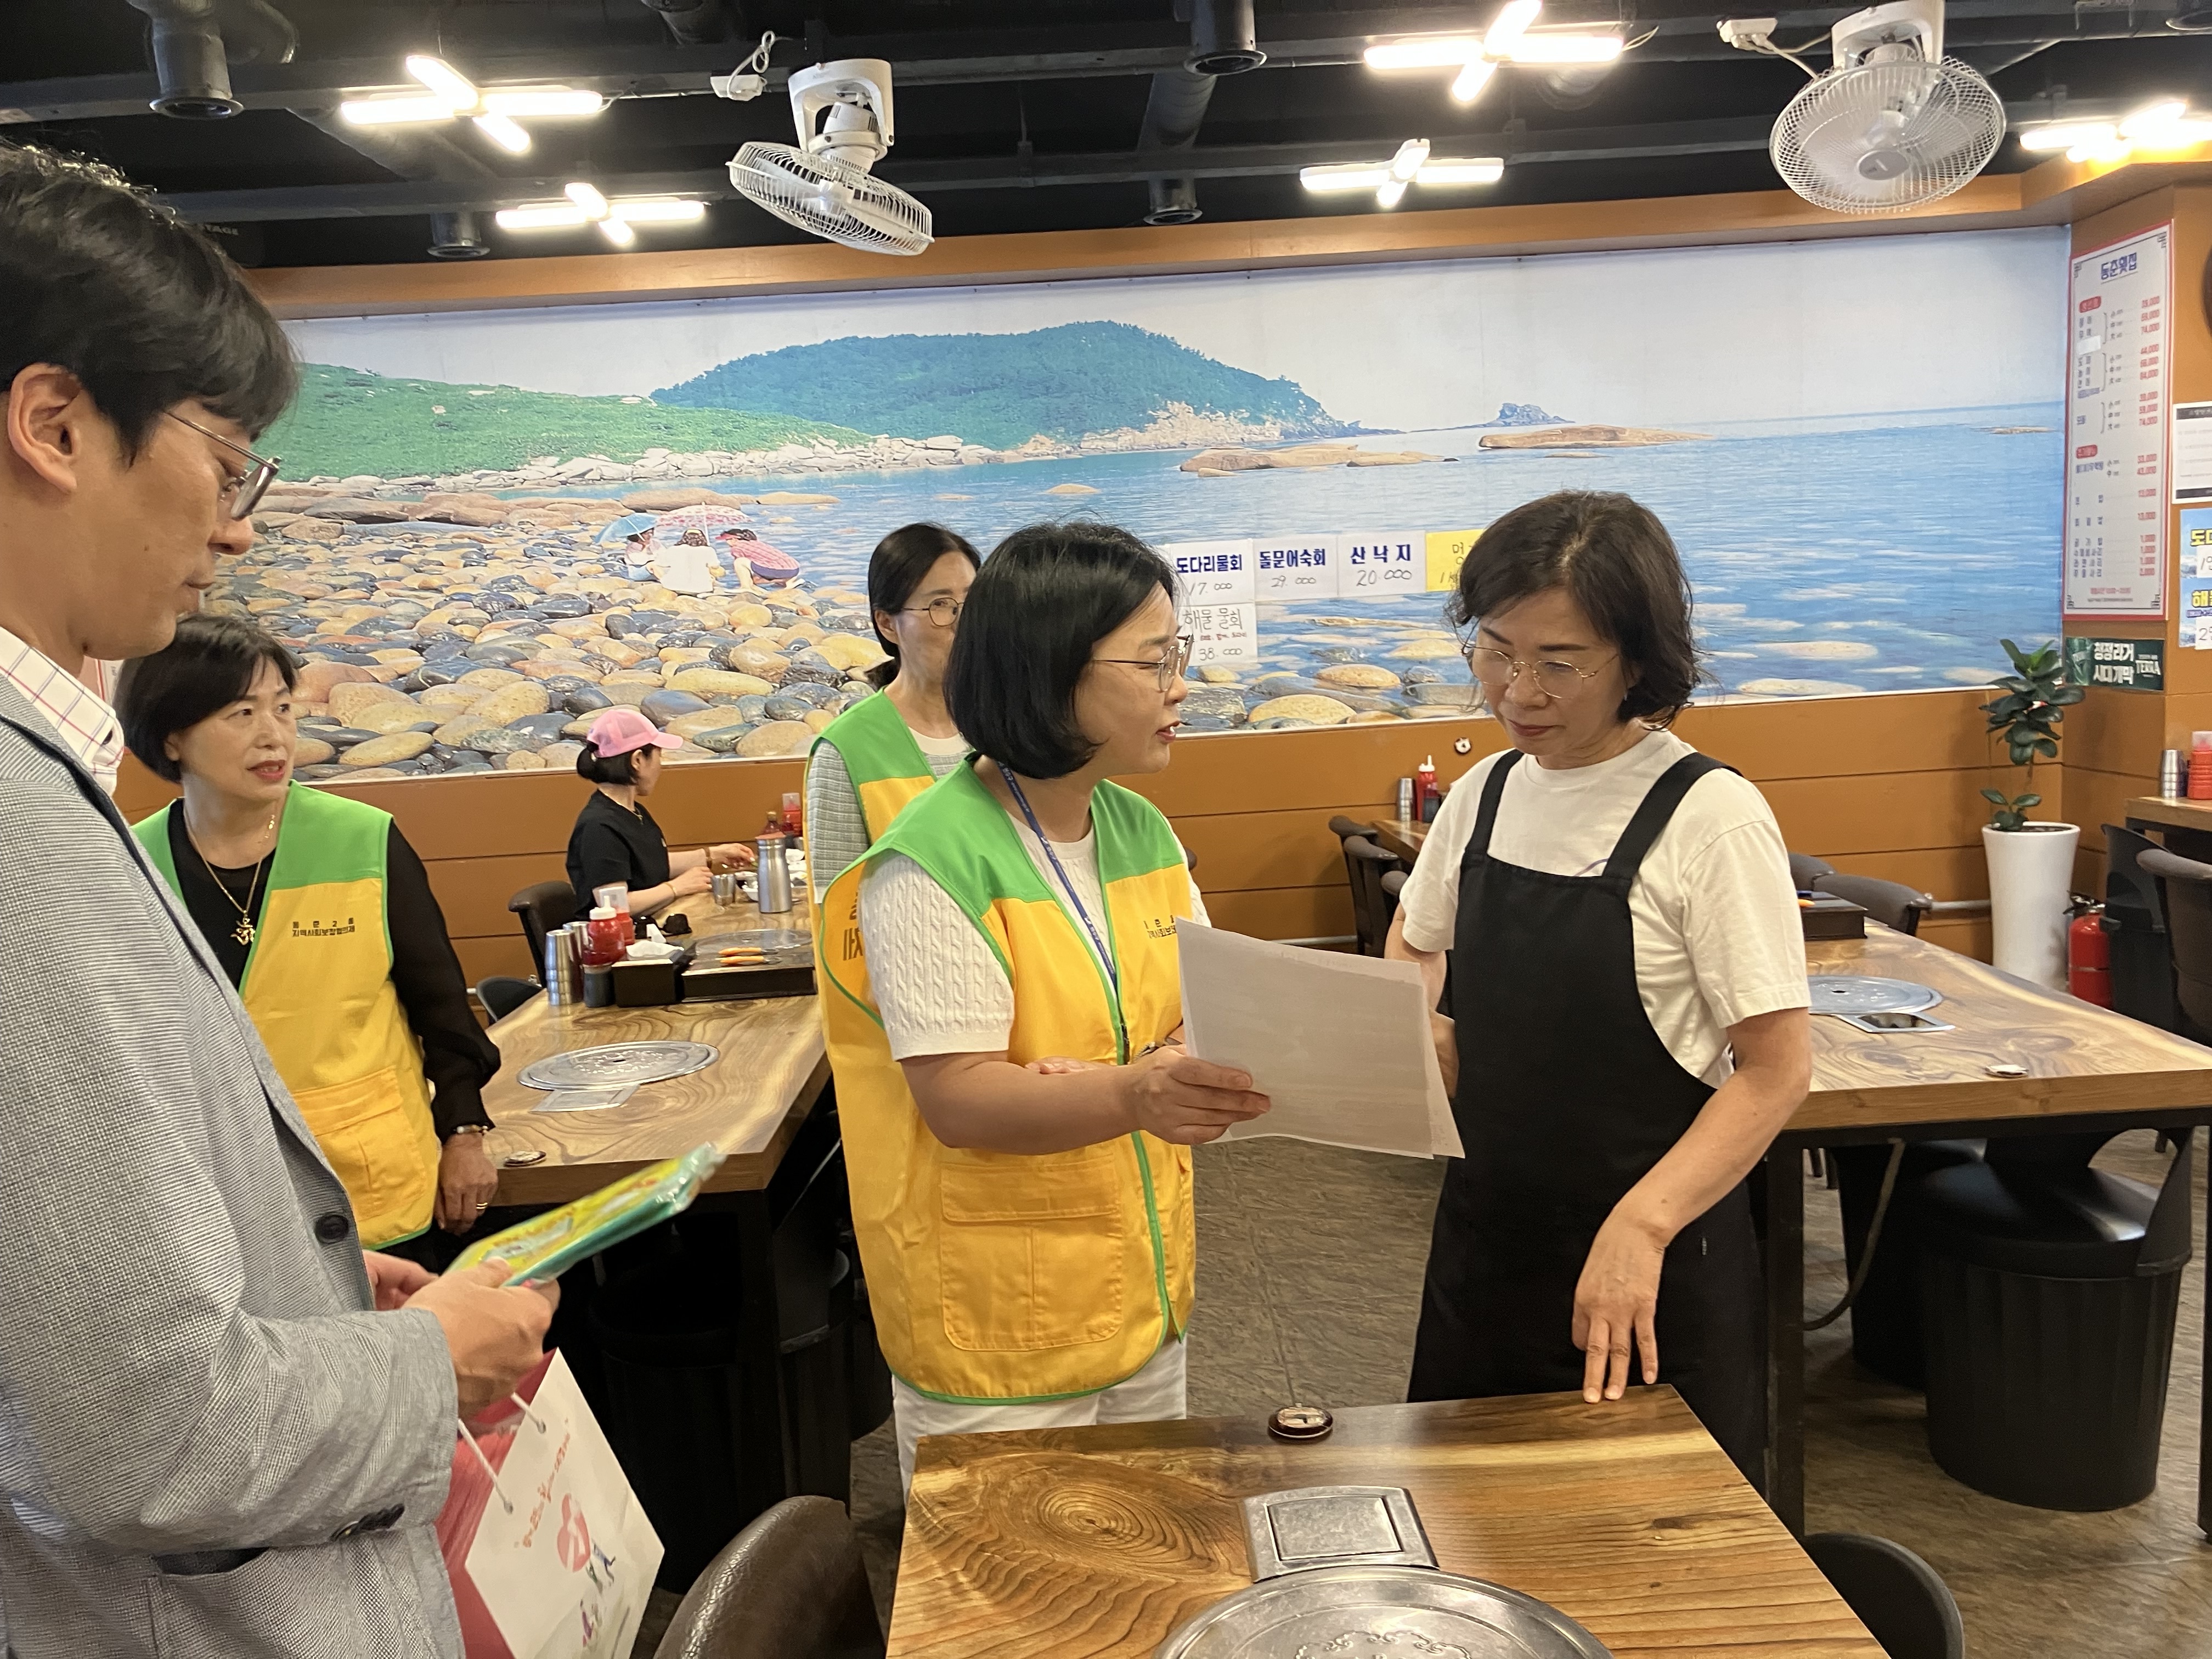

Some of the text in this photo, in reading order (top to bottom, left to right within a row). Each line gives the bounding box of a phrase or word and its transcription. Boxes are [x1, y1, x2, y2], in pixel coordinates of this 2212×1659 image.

[1176, 554, 1243, 573] 도다리물회
[1259, 548, 1326, 569] 돌문어숙회
[2094, 641, 2134, 662] 청정라거
[2093, 664, 2134, 685] 시대개막
